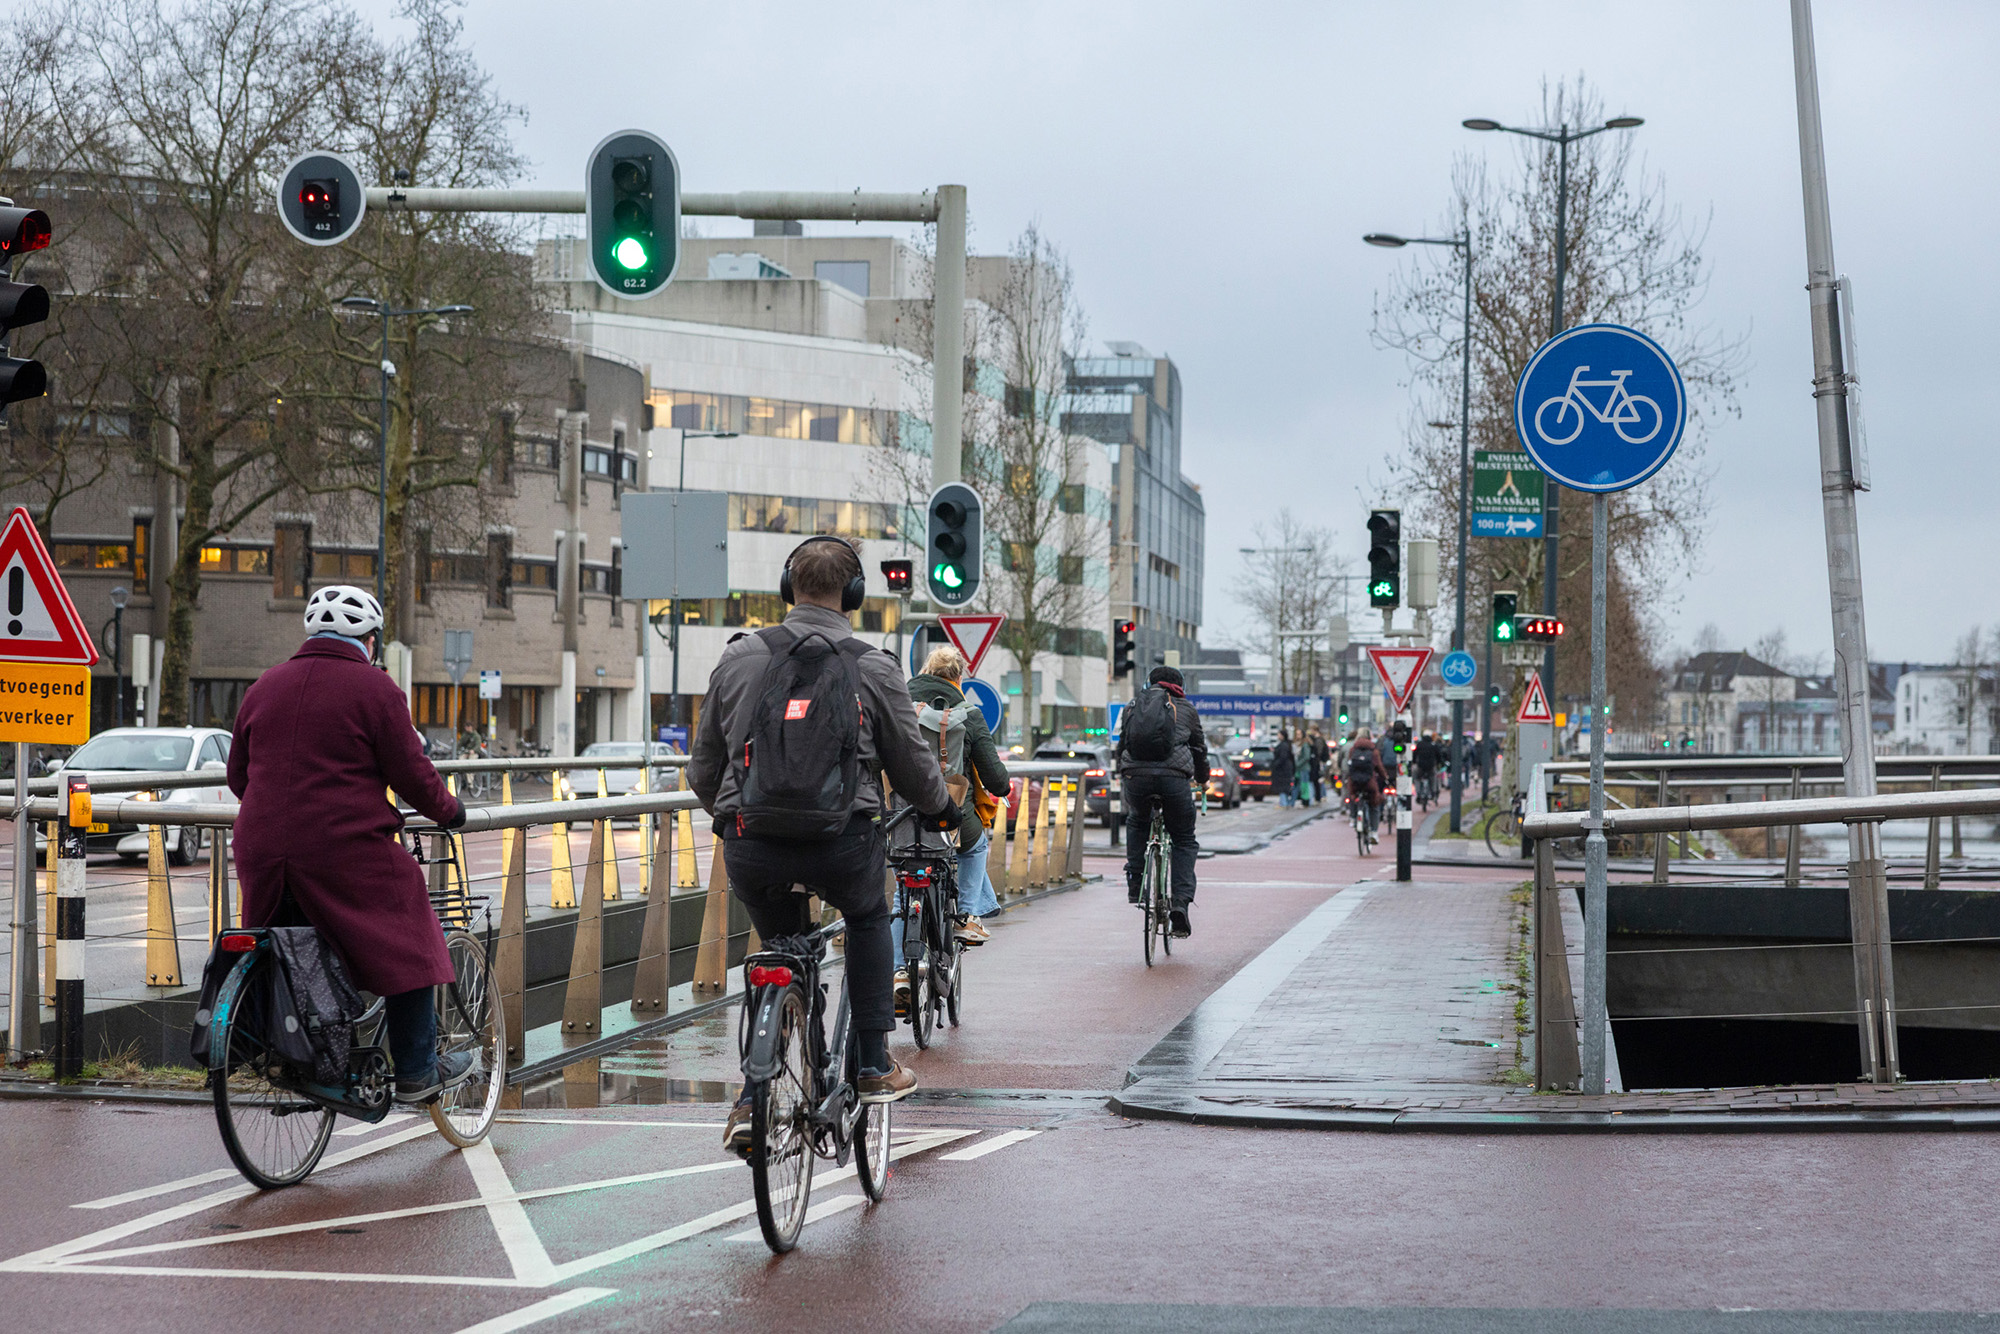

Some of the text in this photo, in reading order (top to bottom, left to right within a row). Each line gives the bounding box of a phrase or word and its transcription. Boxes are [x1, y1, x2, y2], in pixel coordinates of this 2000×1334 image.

[624, 278, 647, 288] 62.2
[1477, 462, 1540, 471] RESTAURAN
[1476, 496, 1540, 506] NAMASKAR
[1477, 519, 1505, 529] 100 m
[1222, 700, 1232, 710] in
[1234, 701, 1260, 712] Hoog
